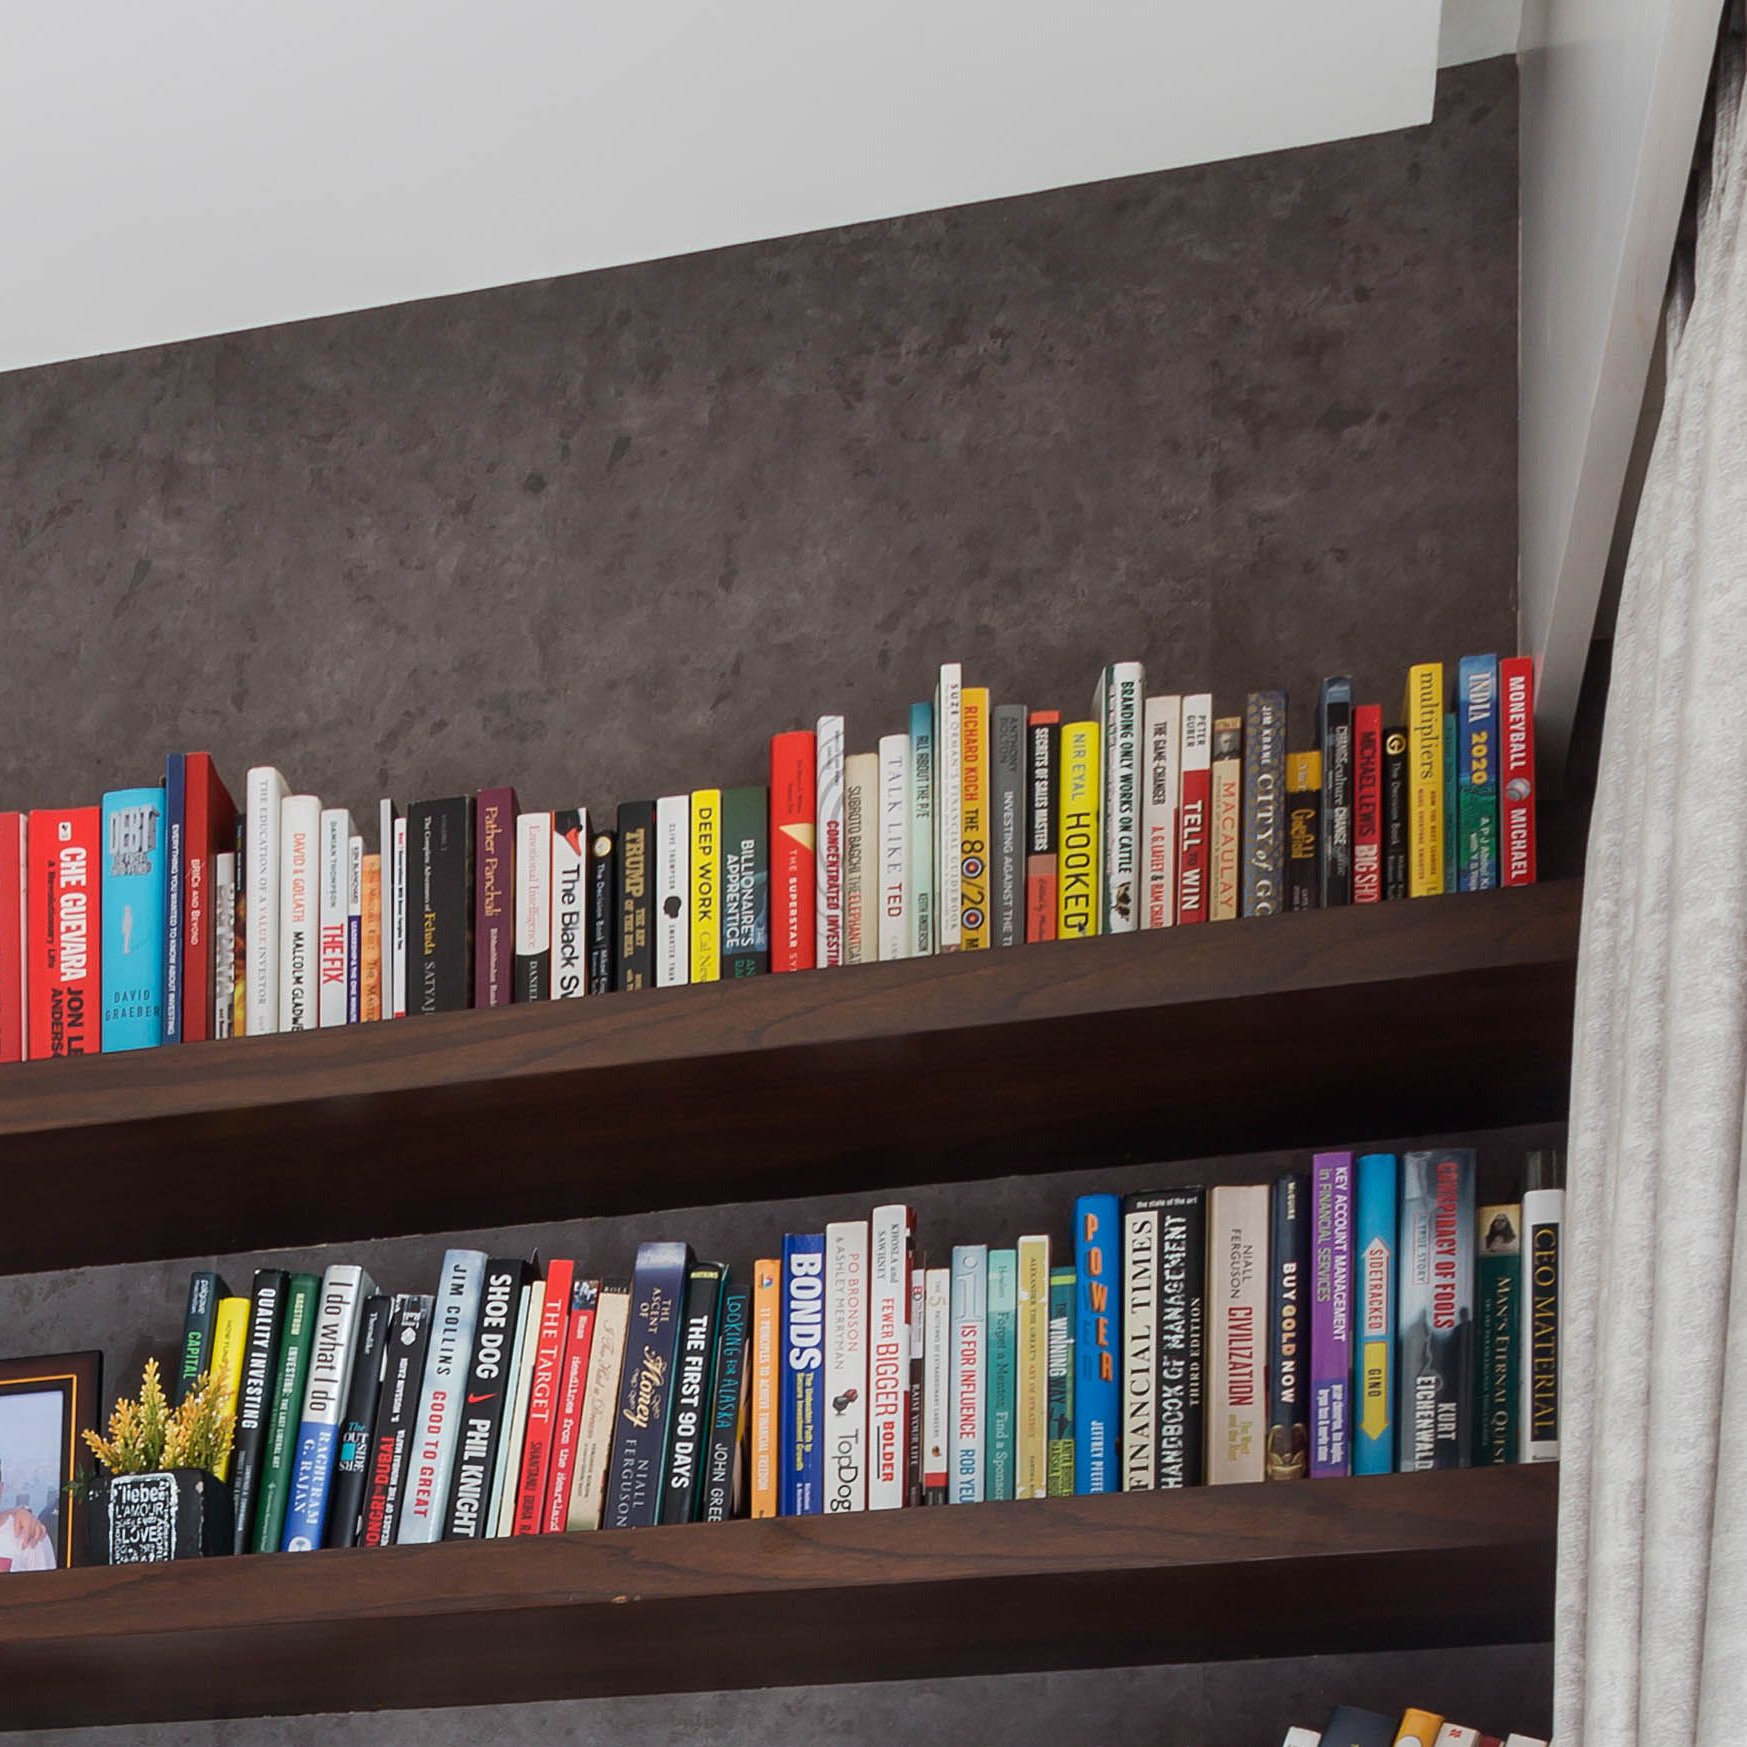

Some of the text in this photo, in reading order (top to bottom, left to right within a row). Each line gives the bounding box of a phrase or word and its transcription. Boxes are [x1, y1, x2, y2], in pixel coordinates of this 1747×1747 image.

[964, 706, 978, 764] RICHARD
[1120, 681, 1134, 874] BRANDING ONLY WORKS ON CATTLE
[1419, 671, 1432, 780] multipliers
[1467, 671, 1490, 785] INDIA 2020
[1510, 675, 1525, 770] MONEYBALL
[964, 766, 979, 802] KOCH
[964, 808, 980, 832] THE
[698, 807, 712, 921] DEEP WORK
[1065, 811, 1091, 932] HOOKED
[1181, 800, 1202, 911] TELL WIN
[58, 847, 87, 981] CHE GUEVARA
[322, 923, 344, 984] THE FIX
[562, 865, 581, 971] The Black
[316, 1324, 346, 1365] what
[325, 1293, 342, 1316] do
[789, 1253, 822, 1370] BONDS
[1084, 1213, 1114, 1382] POWER
[1280, 1263, 1297, 1403] BUY GOLD NOW
[183, 1331, 202, 1379] CAPITAL
[242, 1289, 275, 1429] QUALITY INVESTING
[309, 1390, 336, 1412] do
[413, 1264, 467, 1518] JIM COLLINS GOOD TO GREAT
[453, 1274, 512, 1538] SHOE DOG PHIL KNIGHT
[672, 1315, 708, 1490] THE FIRST 90 DAYS
[875, 1298, 899, 1482] FEWER BIGGER BOLDER
[1127, 1219, 1152, 1491] FINANCIAL TIMES
